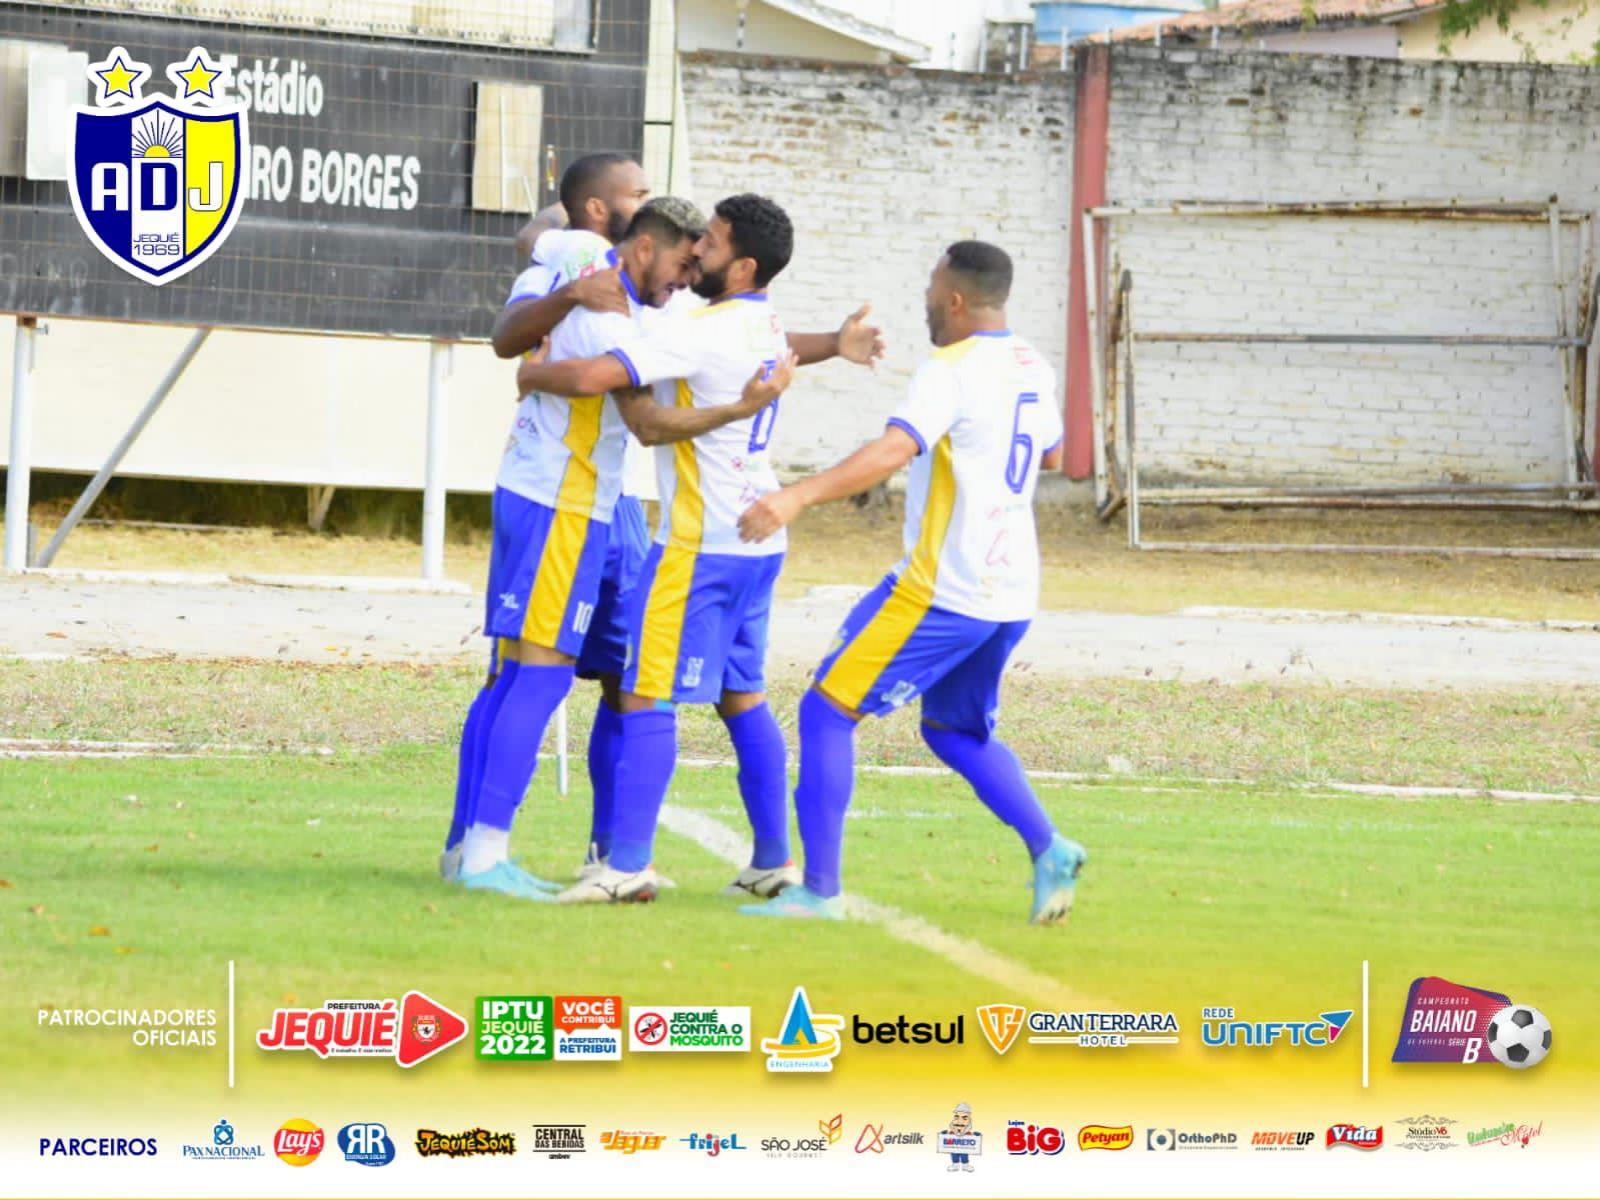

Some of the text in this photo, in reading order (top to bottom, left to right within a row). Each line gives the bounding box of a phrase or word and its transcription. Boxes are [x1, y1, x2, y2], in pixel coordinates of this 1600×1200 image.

[300, 147, 421, 211] BORGES
[1005, 392, 1039, 494] 6
[572, 600, 597, 635] 10
